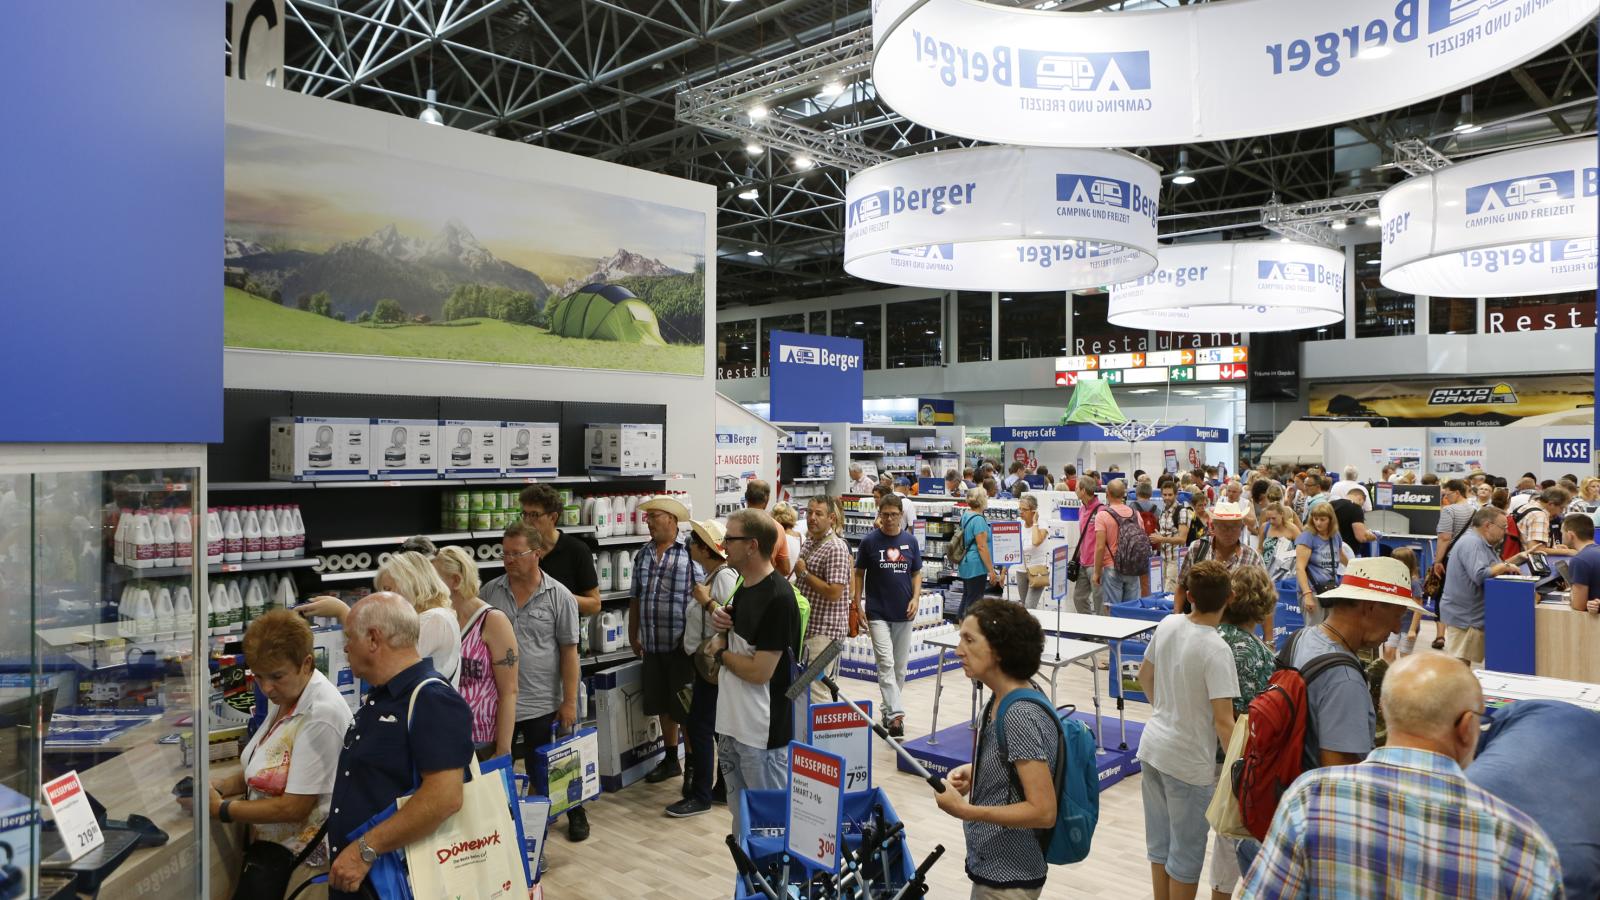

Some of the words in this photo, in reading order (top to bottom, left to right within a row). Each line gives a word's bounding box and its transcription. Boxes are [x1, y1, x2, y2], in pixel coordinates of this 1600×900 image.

[893, 182, 976, 215] Berger
[1132, 184, 1158, 229] Berg
[1056, 206, 1091, 218] CAMPING
[1092, 208, 1107, 220] UND
[1107, 211, 1131, 225] FREIZEIT
[1465, 214, 1505, 229] CAMPING
[1507, 209, 1528, 222] UND
[1530, 204, 1575, 219] FREIZEIT
[1489, 306, 1598, 334] Rest
[1075, 331, 1240, 355] Restaurant
[821, 348, 859, 372] Berger
[1435, 388, 1490, 396] AUTO
[1431, 395, 1487, 403] CAMP
[733, 433, 757, 445] Berger
[1012, 428, 1039, 440] Bergers
[1039, 427, 1057, 437] Café
[1458, 436, 1481, 446] Berger
[1433, 449, 1483, 457] ZELT-ANGEBOTE
[1546, 442, 1588, 459] KASSE
[879, 550, 886, 562] I
[879, 562, 908, 570] camping
[815, 711, 867, 724] MESSEPREI
[794, 754, 838, 778] MESSEPREIS
[792, 786, 809, 797] SMART
